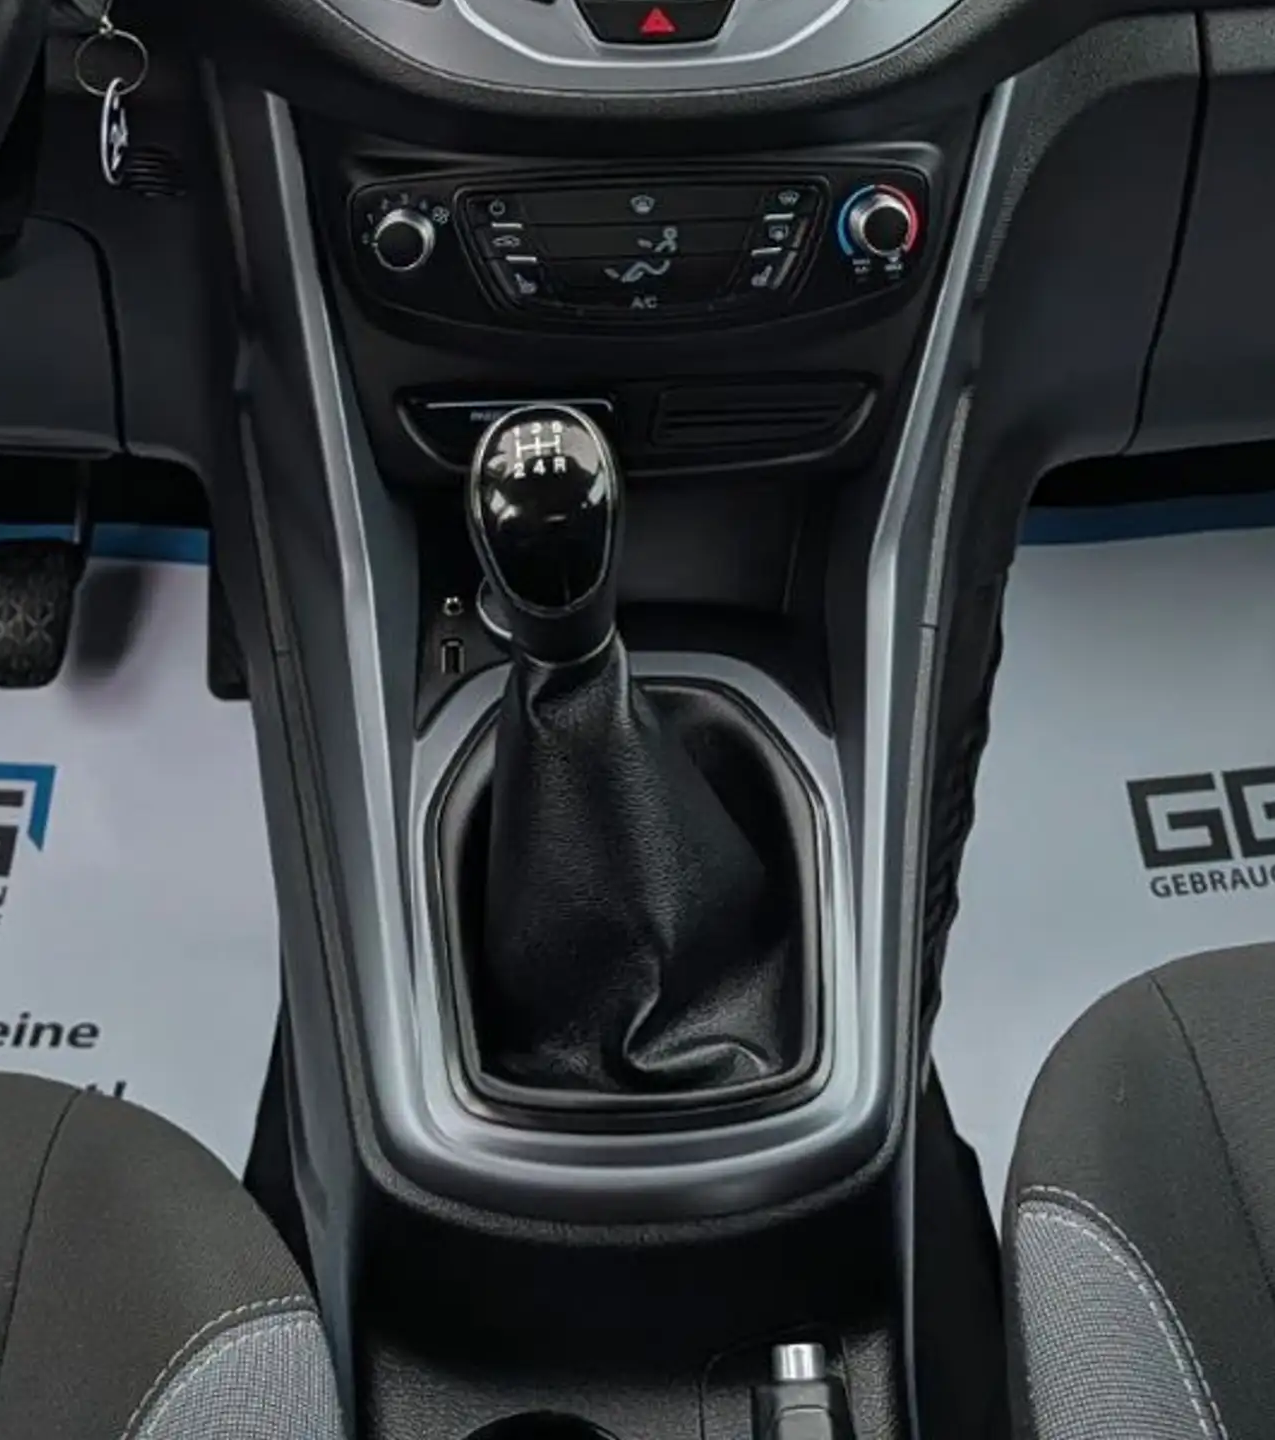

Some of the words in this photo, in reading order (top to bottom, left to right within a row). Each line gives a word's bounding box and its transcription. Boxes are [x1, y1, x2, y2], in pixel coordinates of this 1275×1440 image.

[513, 461, 526, 479] 2
[532, 458, 546, 476] 4
[552, 456, 567, 474] R
